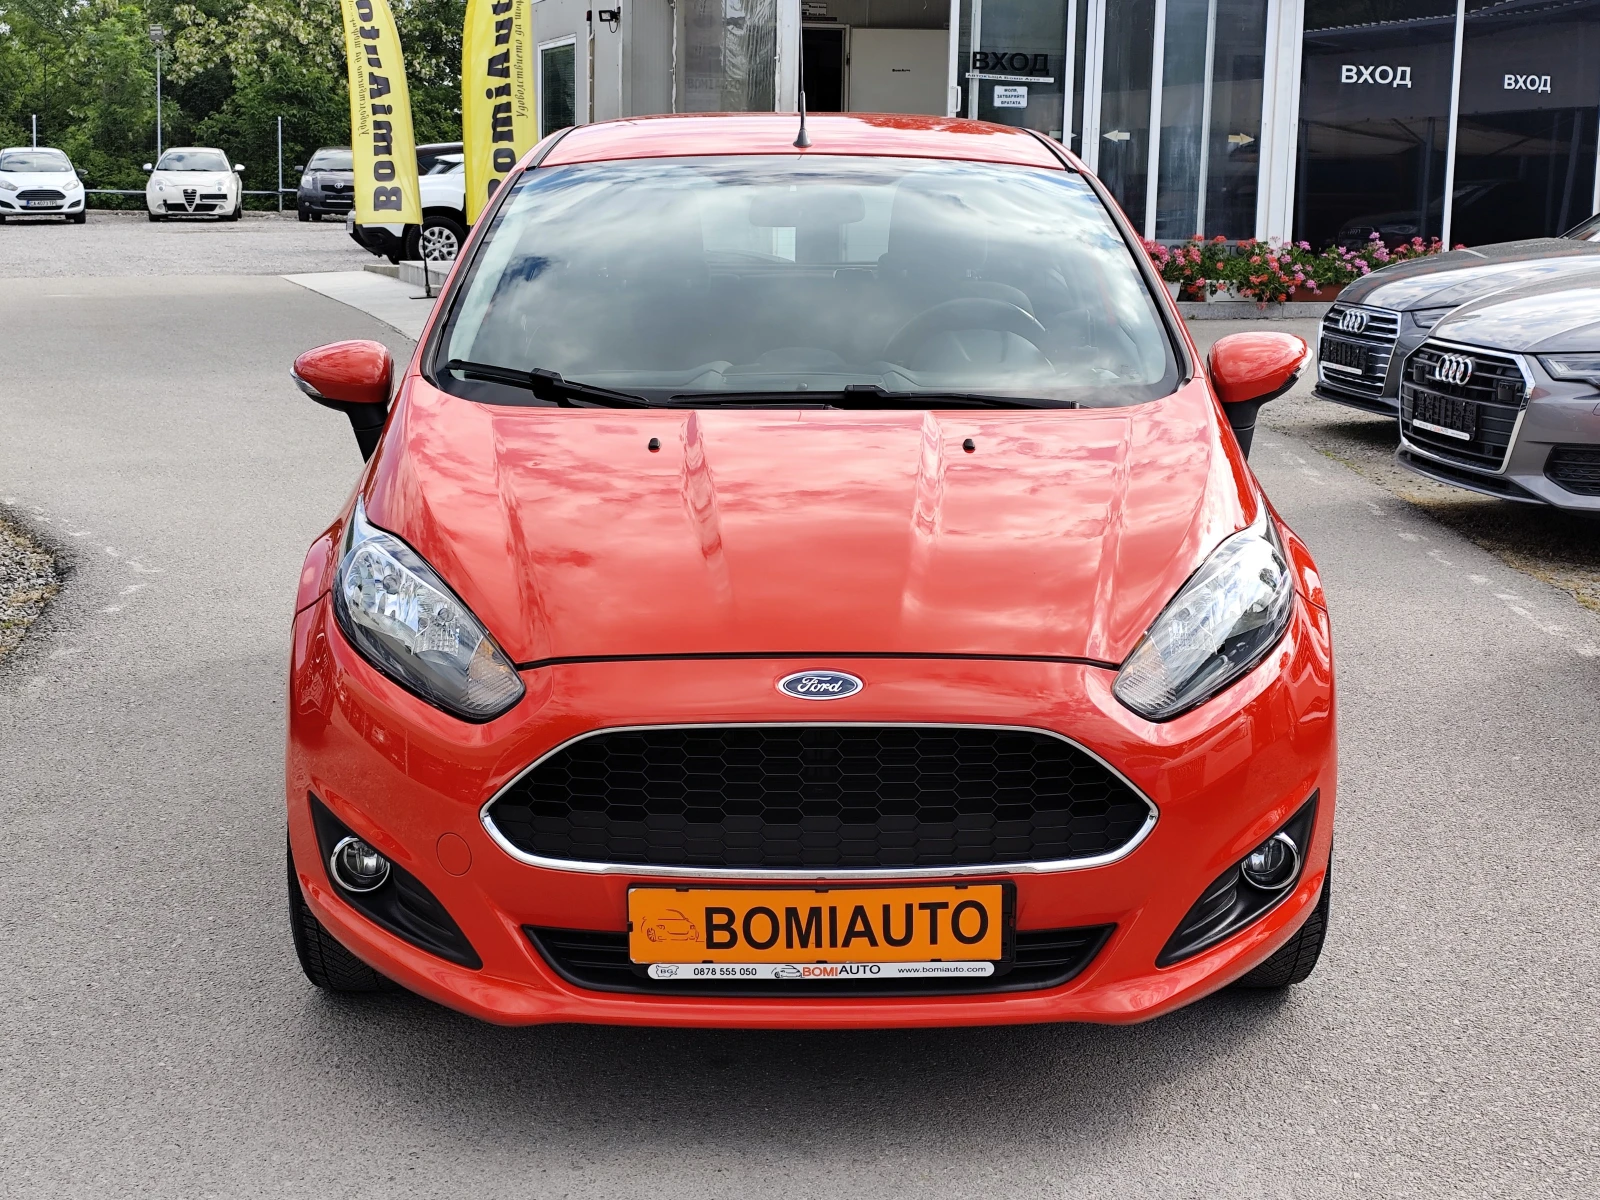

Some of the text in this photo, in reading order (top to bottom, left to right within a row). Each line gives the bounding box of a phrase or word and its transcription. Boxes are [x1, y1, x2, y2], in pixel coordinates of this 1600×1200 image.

[516, 23, 526, 37] да
[973, 52, 1049, 75] ВХОД
[1341, 64, 1412, 88] ВХОД
[1503, 74, 1551, 93] ВХОД
[797, 676, 843, 692] Ford
[704, 899, 989, 950] BOMIAUTO
[693, 967, 757, 976] 0878 555 050
[897, 966, 986, 974] www.bomiauto.com
